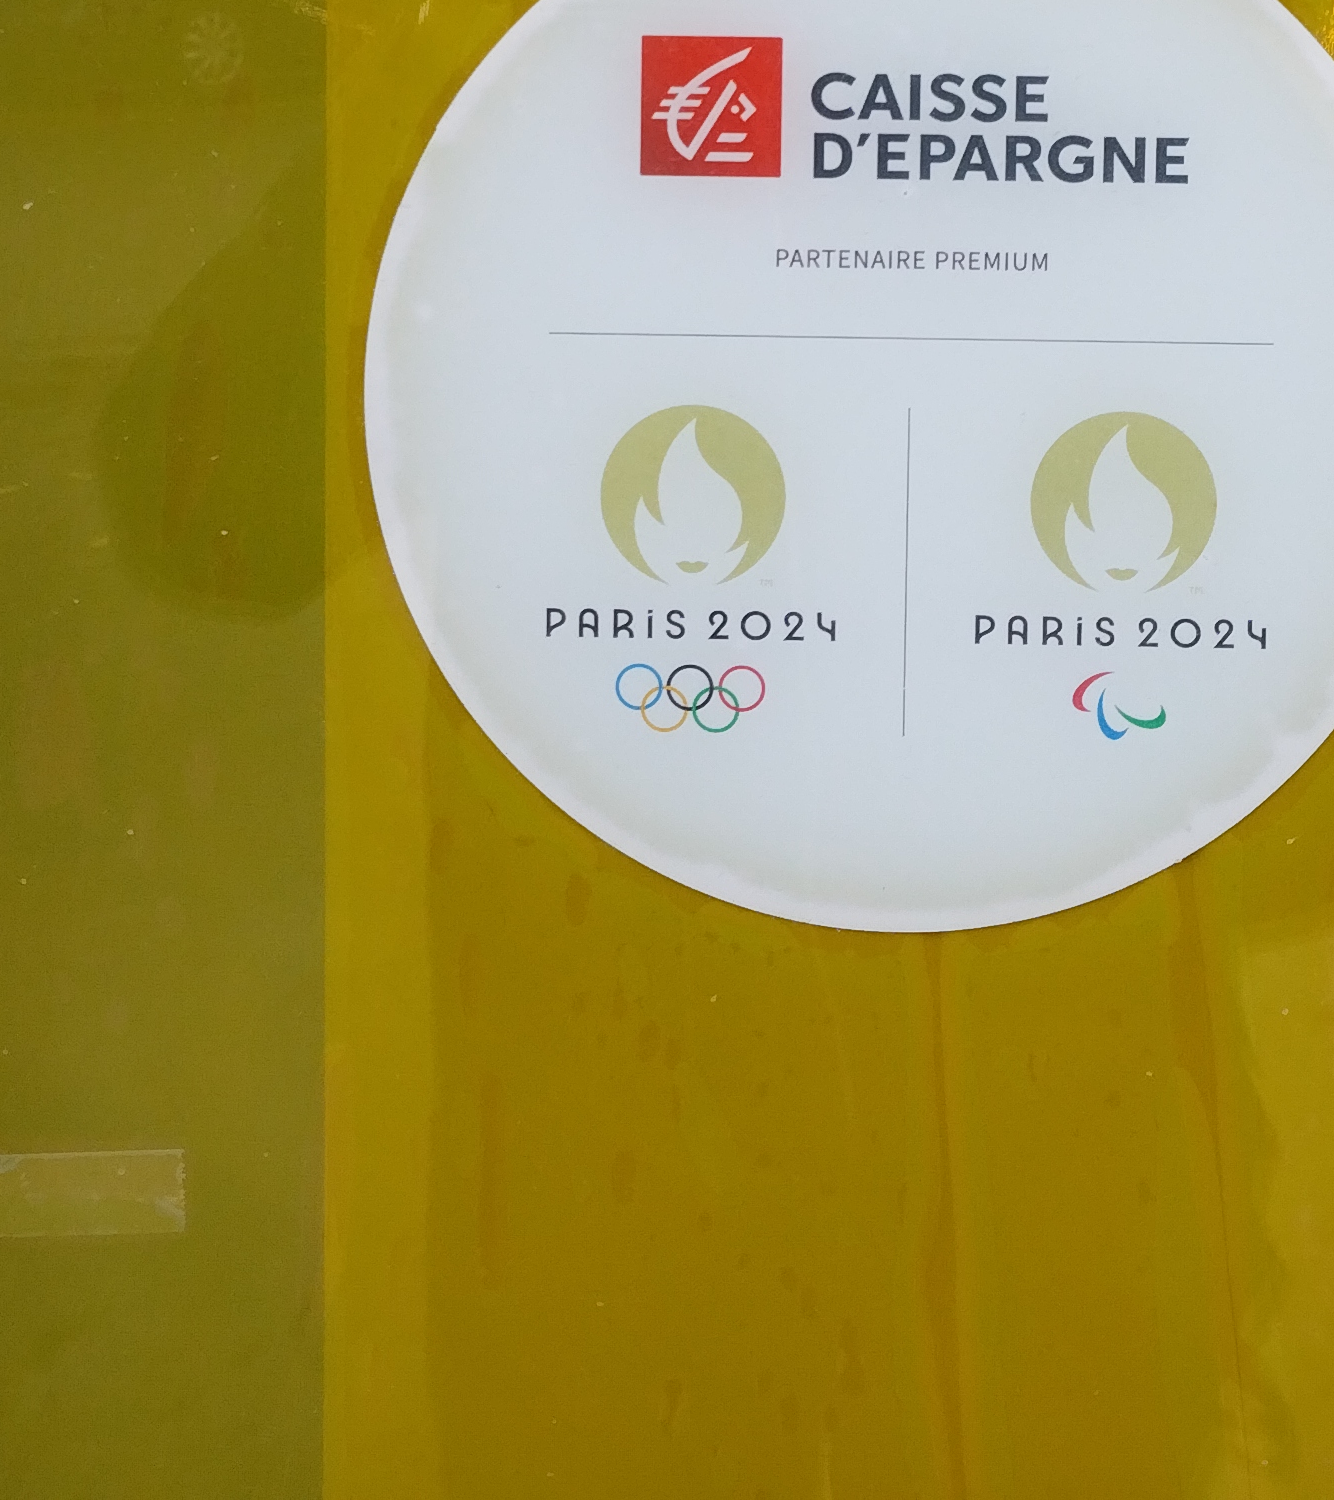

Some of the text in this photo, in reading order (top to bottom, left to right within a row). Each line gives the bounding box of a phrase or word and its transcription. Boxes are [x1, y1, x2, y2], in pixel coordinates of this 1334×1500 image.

[810, 72, 1050, 123] CAISSE
[812, 132, 1190, 185] D'EPARGNE
[776, 248, 1048, 272] PARTENAIRE PREMIUM
[708, 610, 836, 642] 2024
[1137, 617, 1267, 650] 2024
